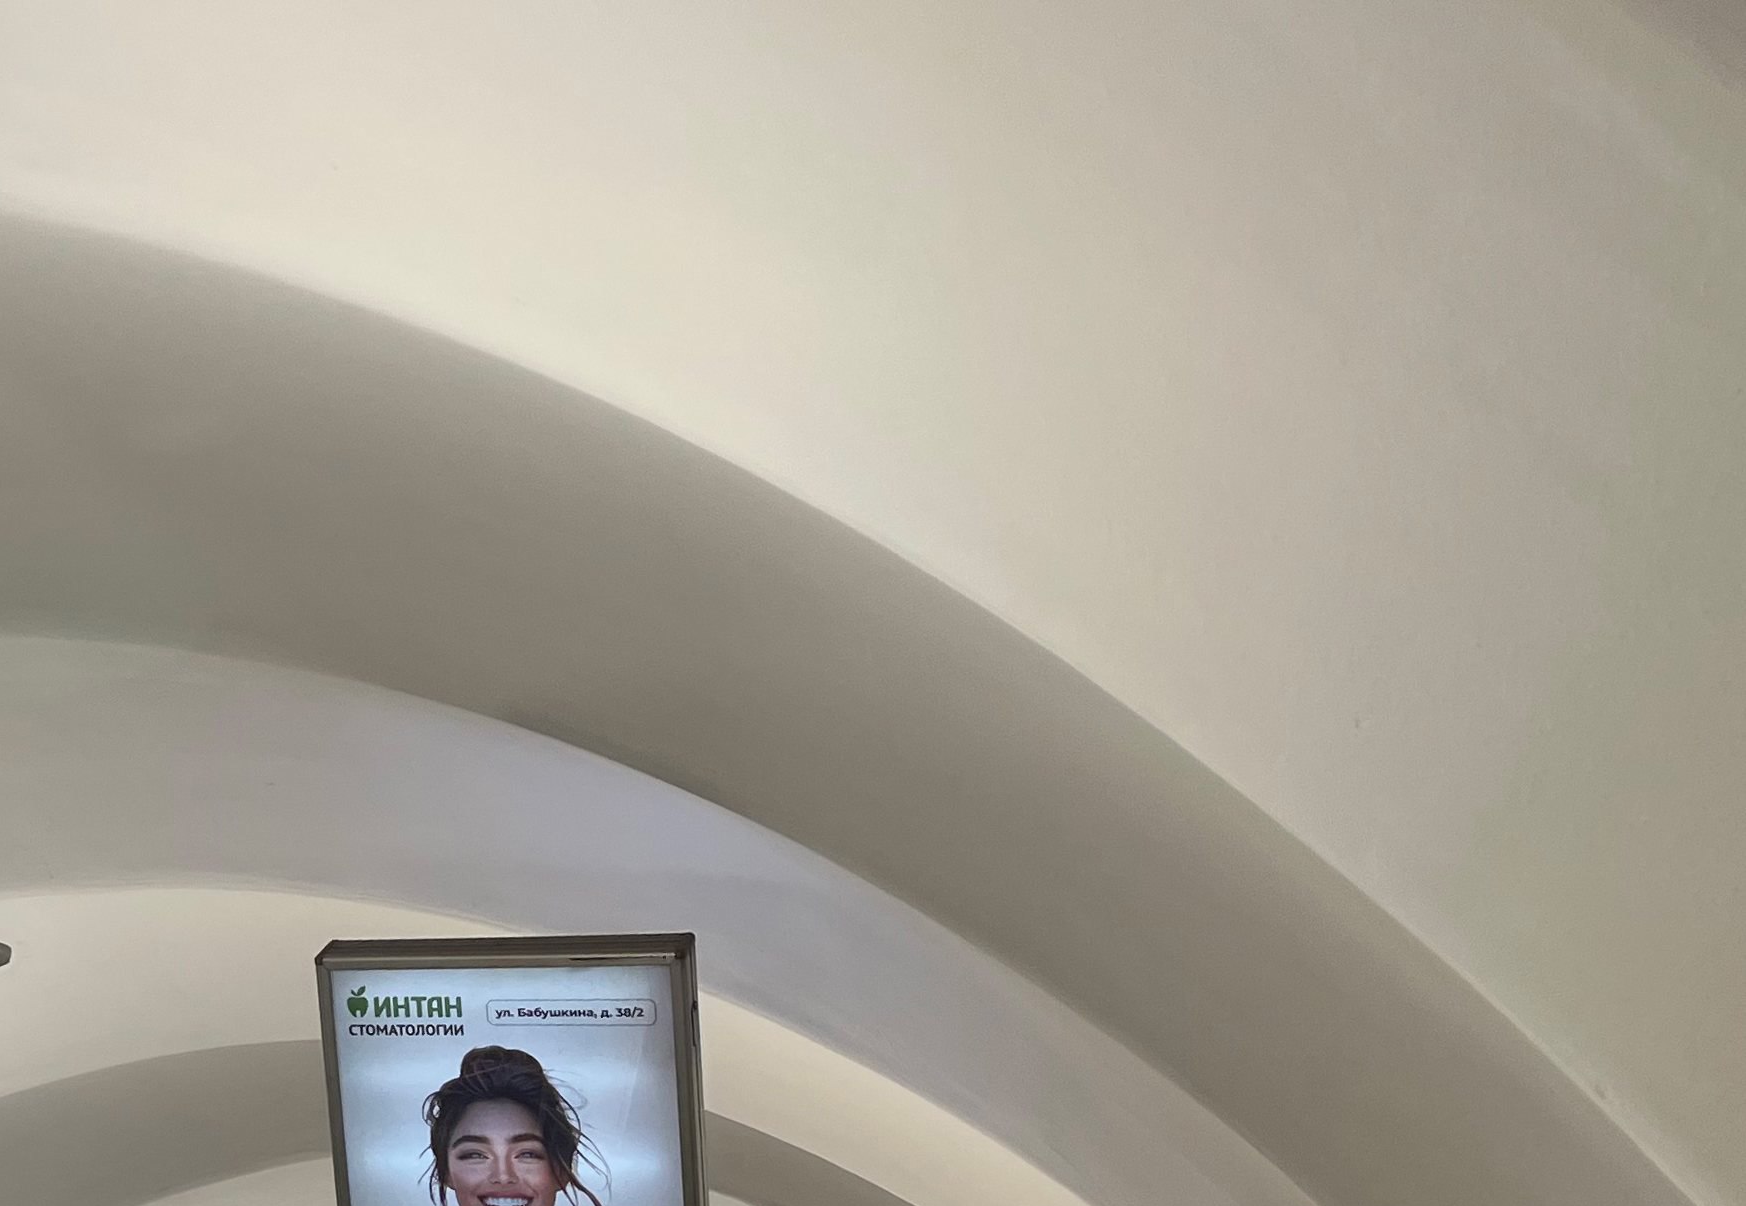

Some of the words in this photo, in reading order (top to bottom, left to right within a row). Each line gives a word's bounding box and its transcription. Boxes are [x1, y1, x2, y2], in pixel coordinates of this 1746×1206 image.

[373, 996, 463, 1018] ИНТАН
[495, 1009, 514, 1019] ул.
[517, 1007, 598, 1019] Бабушкина,
[600, 1009, 613, 1019] д.
[615, 1007, 644, 1019] 38/2
[349, 1024, 465, 1036] СТОМАТОЛОГИИ
